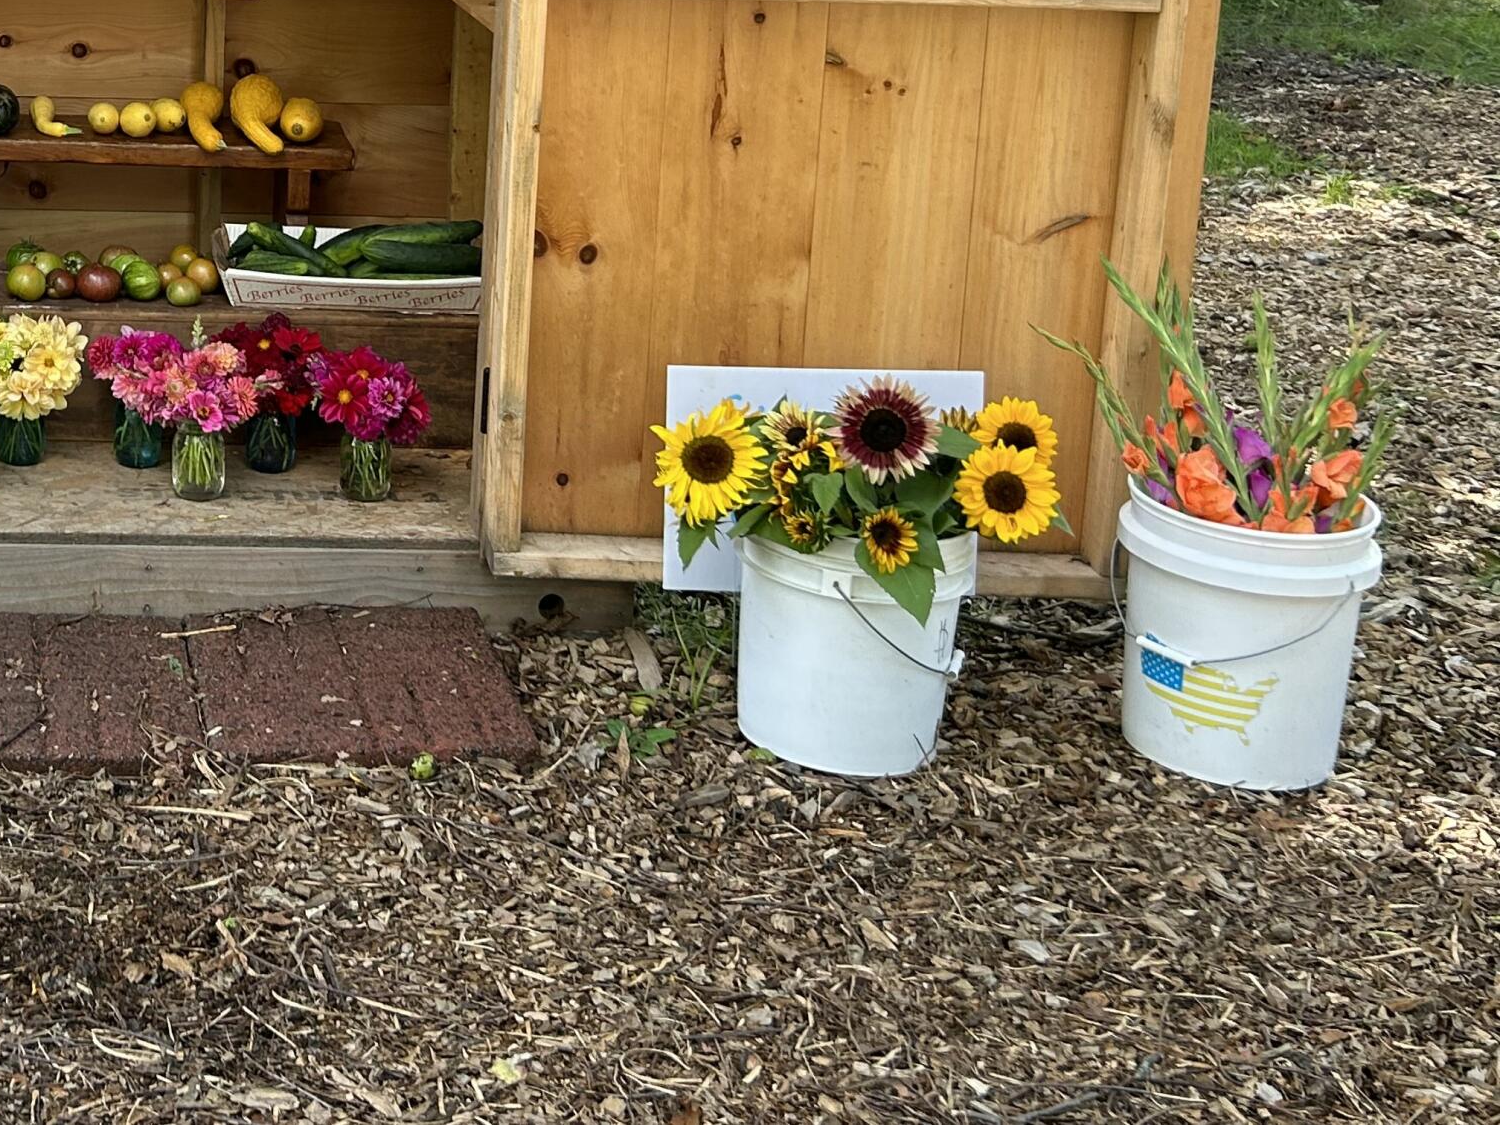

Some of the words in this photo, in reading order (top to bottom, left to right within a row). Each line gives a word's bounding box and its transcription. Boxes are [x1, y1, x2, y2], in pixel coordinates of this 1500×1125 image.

[246, 283, 304, 302] Berries
[300, 287, 357, 304] Berries
[354, 287, 411, 306] Berries
[408, 287, 467, 309] Berries
